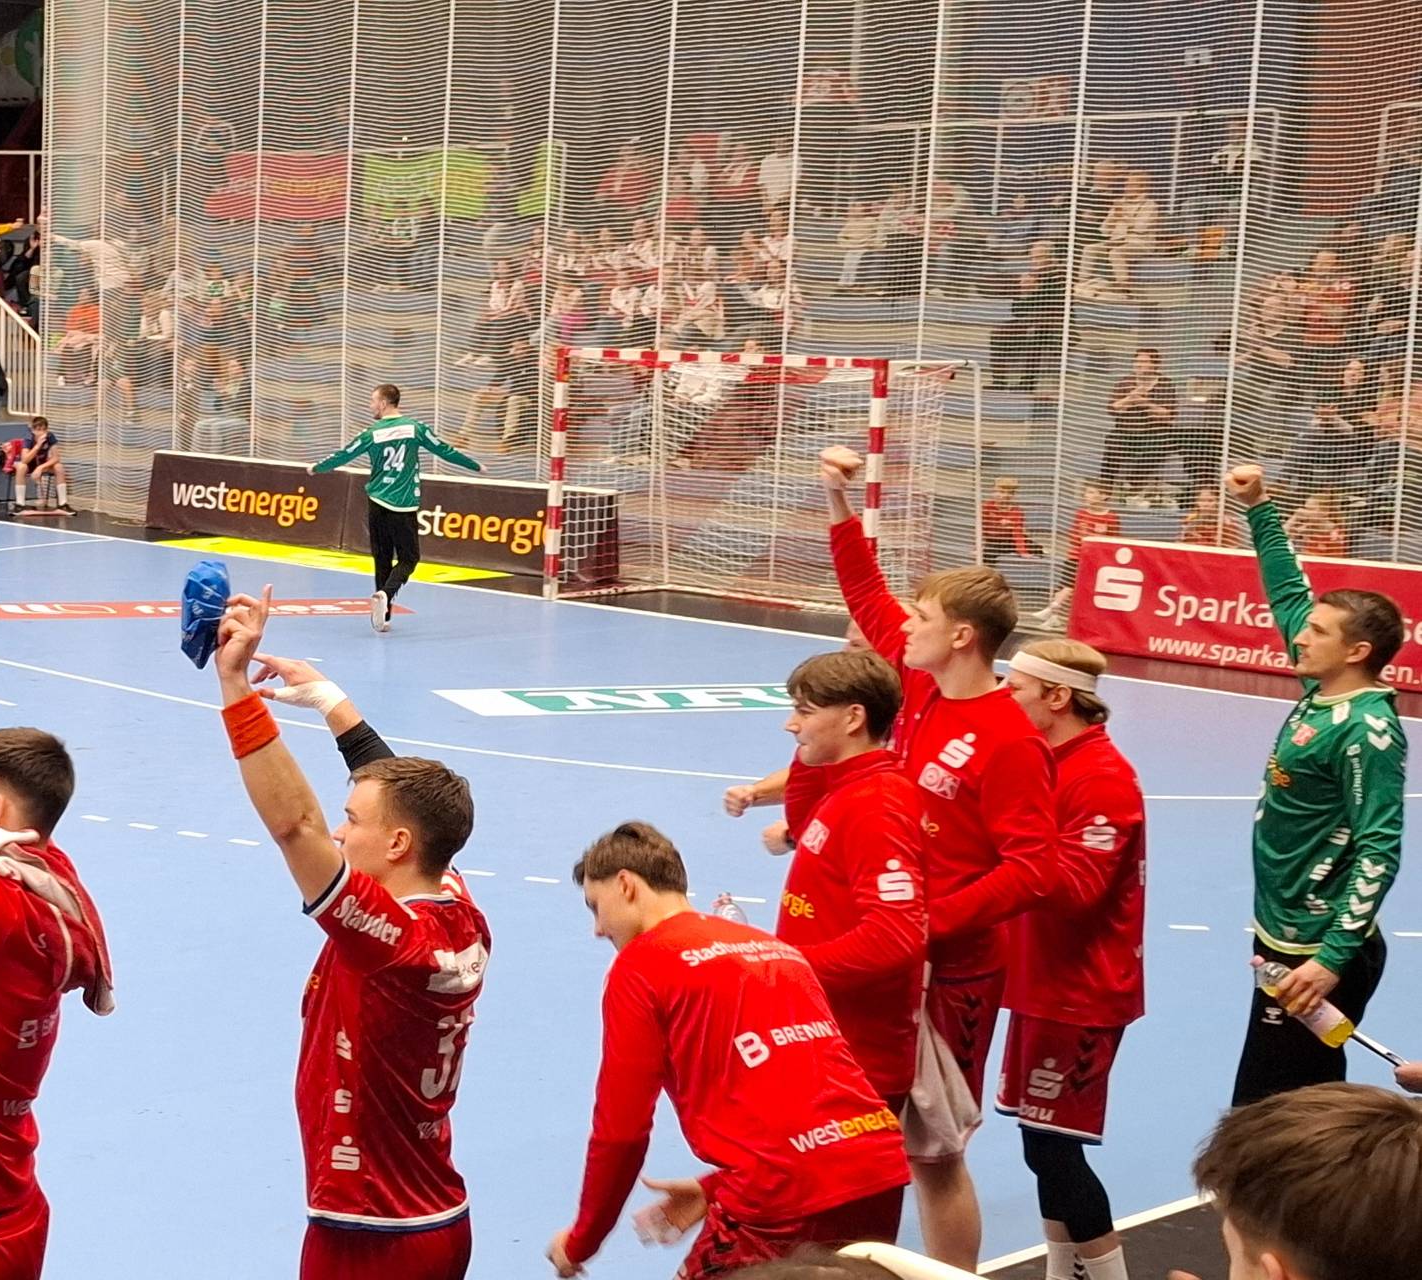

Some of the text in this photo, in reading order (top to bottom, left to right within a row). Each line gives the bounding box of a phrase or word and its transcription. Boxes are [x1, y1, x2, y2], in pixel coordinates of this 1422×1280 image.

[382, 444, 407, 472] 24
[172, 481, 319, 527] westenergie
[416, 505, 546, 555] stenergi
[1154, 584, 1275, 629] Sparka
[332, 894, 404, 946] Stauder
